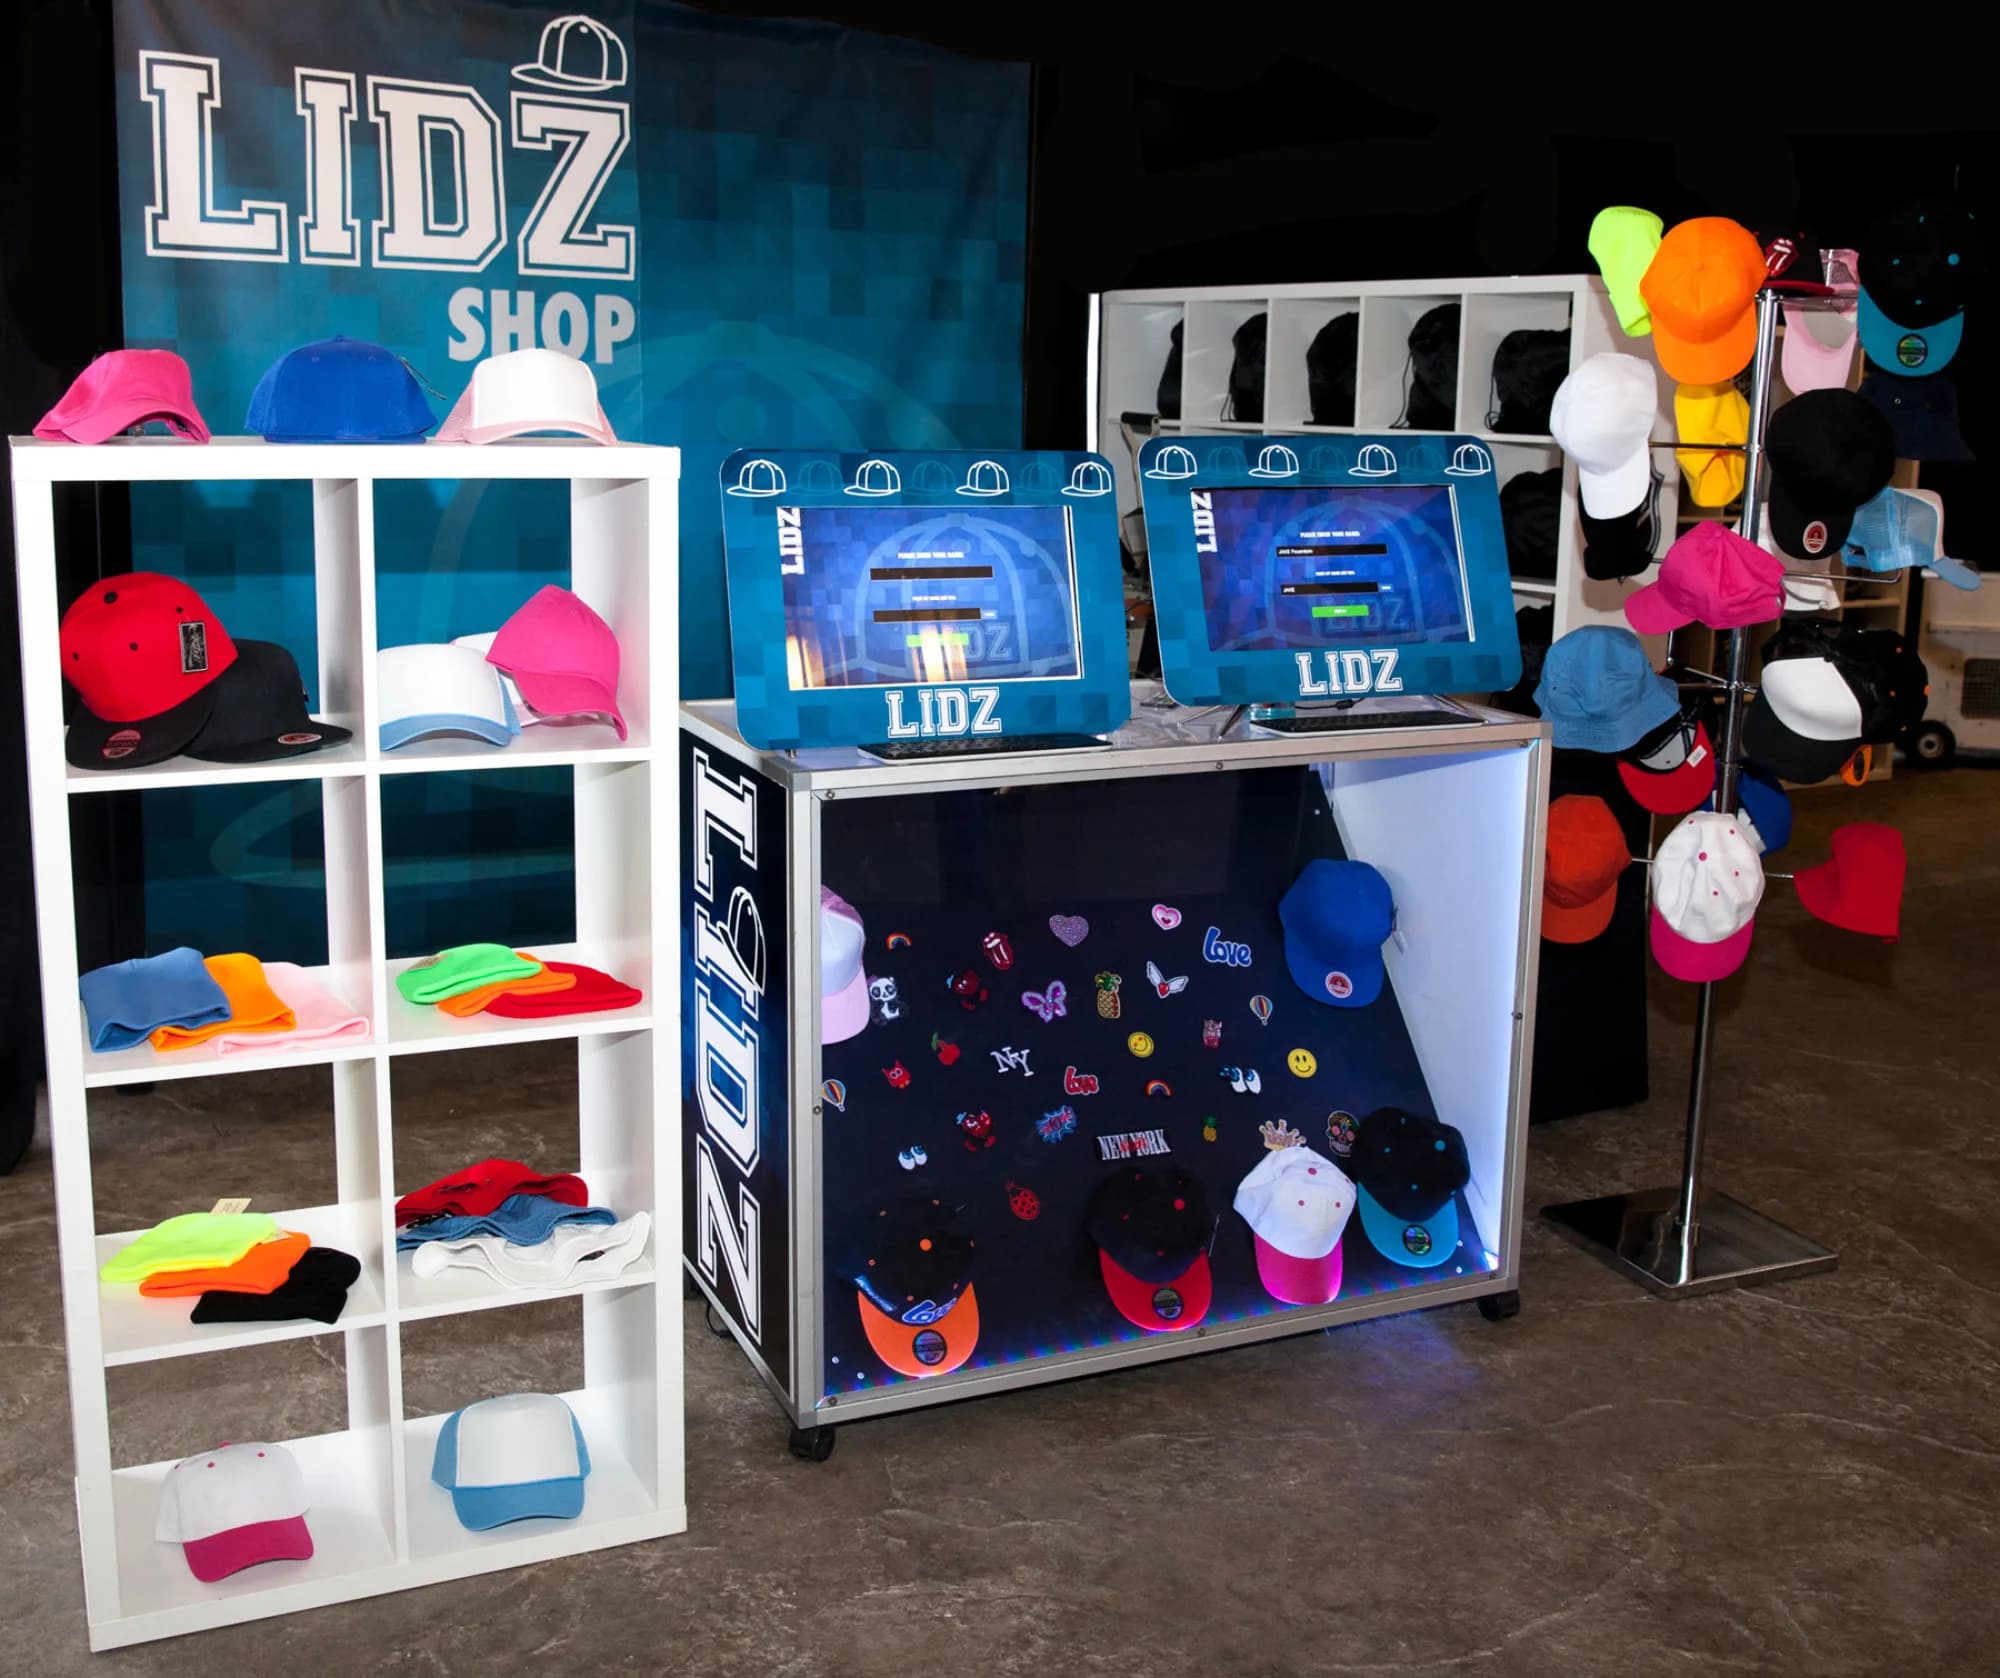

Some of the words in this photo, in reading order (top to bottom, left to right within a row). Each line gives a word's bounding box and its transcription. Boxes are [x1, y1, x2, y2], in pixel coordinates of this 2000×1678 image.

[138, 49, 636, 281] LIDZ
[447, 287, 636, 365] SHOP
[777, 507, 805, 576] LIDZ
[1190, 491, 1218, 554] LIDZ
[1295, 648, 1404, 697] LIDZ
[885, 686, 1002, 739] LIDZ
[693, 747, 762, 1346] LIDZ
[990, 1046, 1035, 1078] NY
[1096, 1133, 1131, 1161] NEW
[1130, 1128, 1172, 1157] YORK
